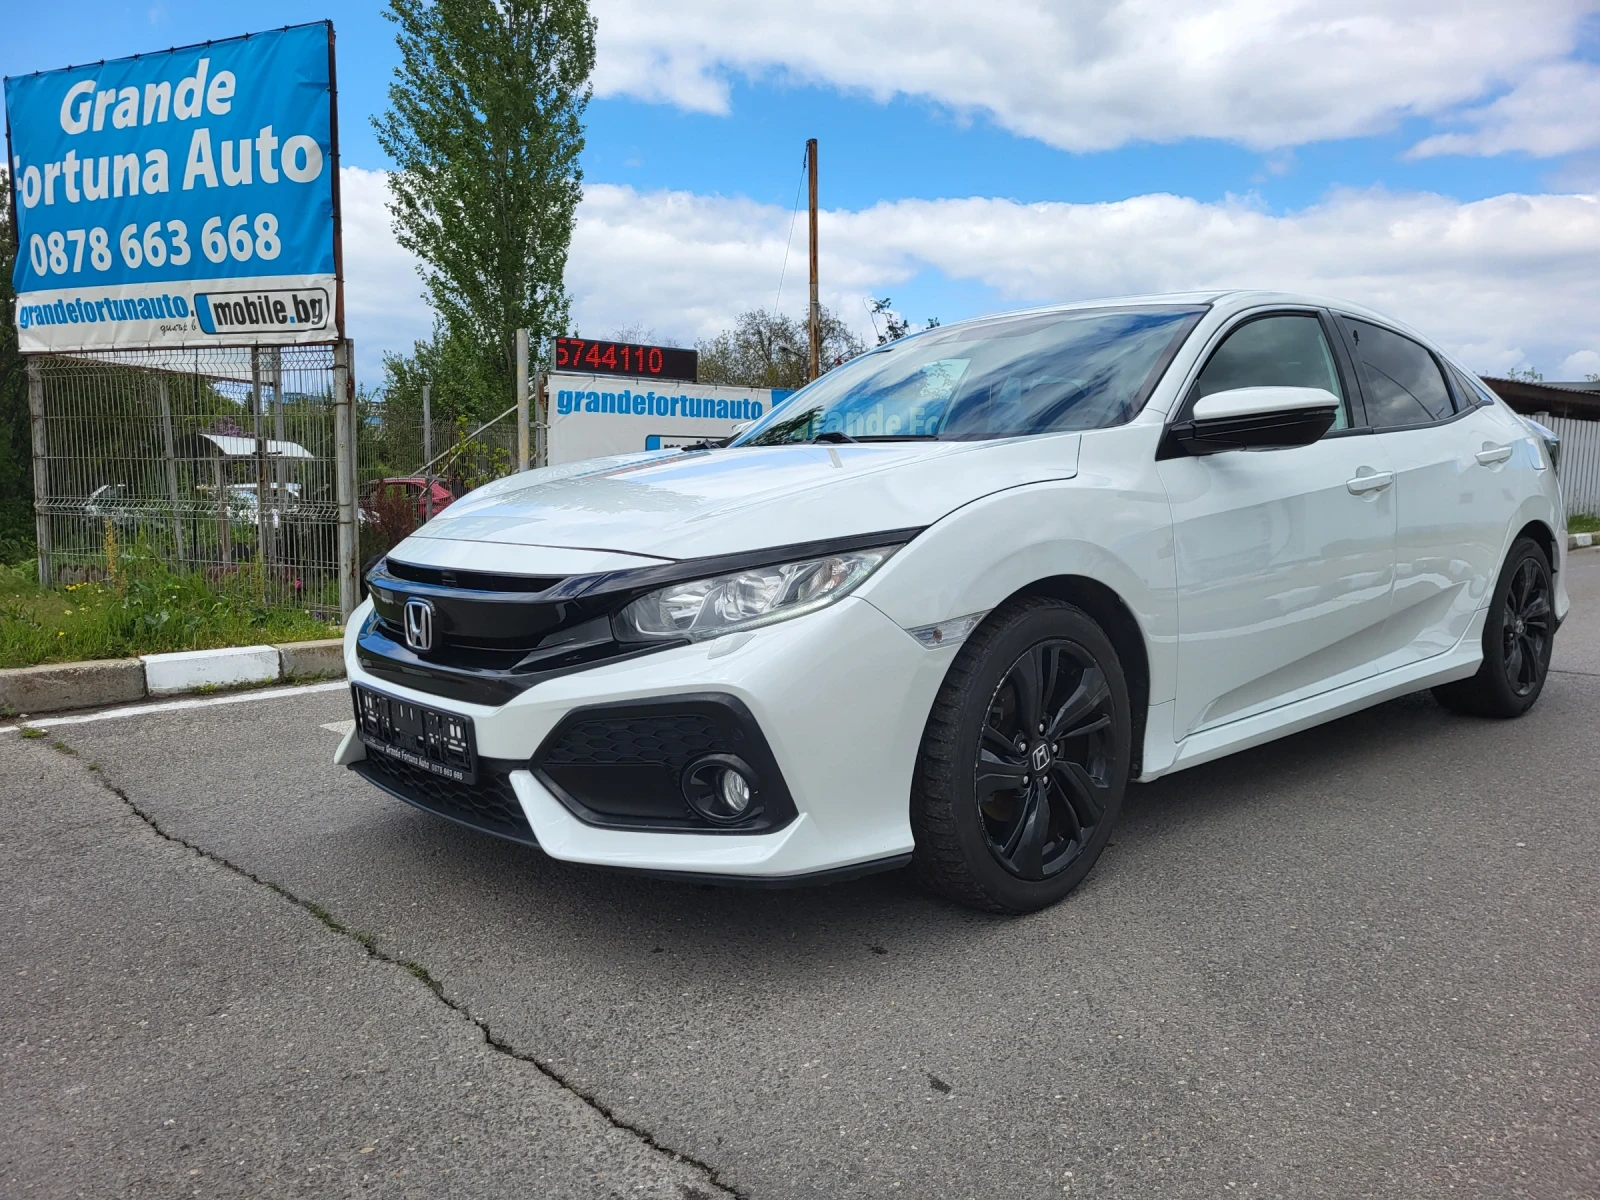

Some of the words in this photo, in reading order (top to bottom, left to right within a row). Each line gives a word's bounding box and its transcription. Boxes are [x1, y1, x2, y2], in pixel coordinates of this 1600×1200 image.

[60, 58, 236, 135] Grande
[182, 125, 323, 190] Auto
[30, 227, 112, 276] 0878
[120, 219, 191, 269] 663
[201, 213, 281, 264] 668
[213, 294, 323, 326] mobile.bg
[557, 389, 763, 420] grandefortunauto
